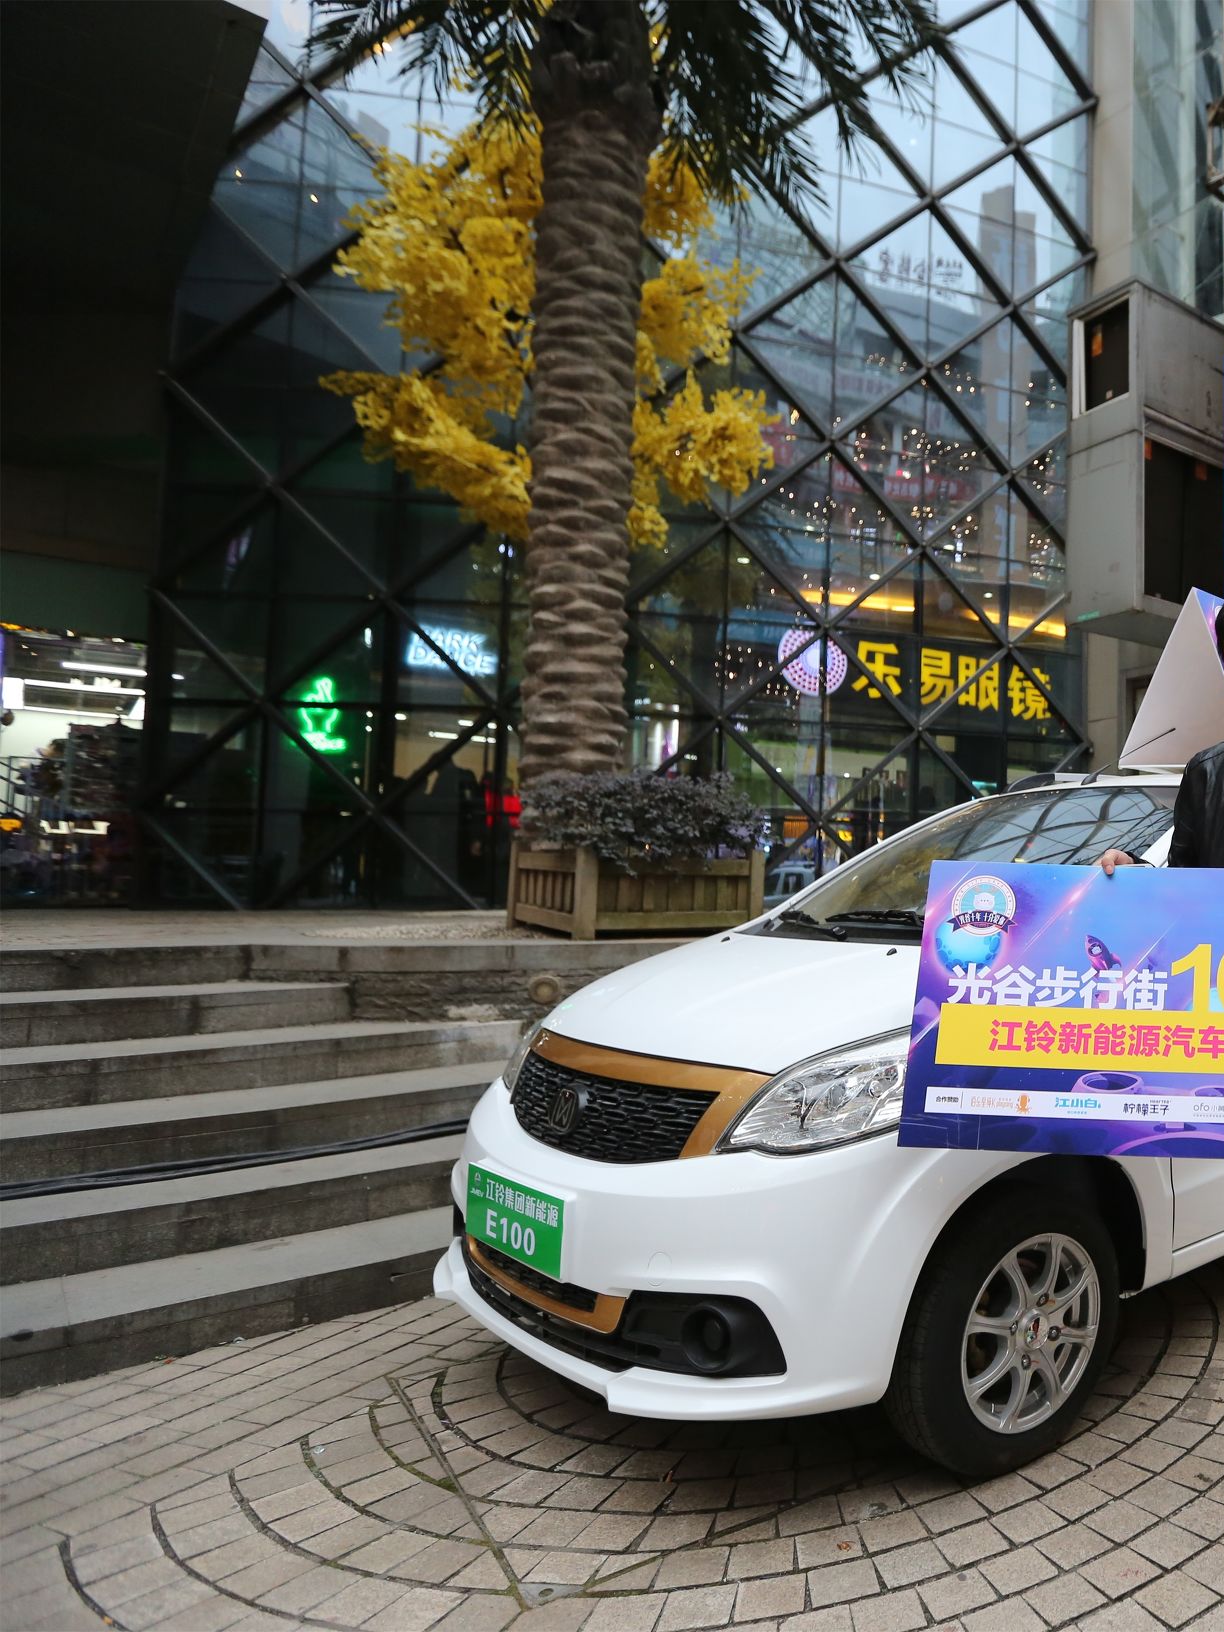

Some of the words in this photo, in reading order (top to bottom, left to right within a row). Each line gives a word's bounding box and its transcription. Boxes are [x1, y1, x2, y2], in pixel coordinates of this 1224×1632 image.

[851, 640, 1052, 721] 乐易眼镜
[1193, 1102, 1209, 1112] ofo
[486, 1178, 559, 1228] 江铃集团新能源
[486, 1208, 536, 1256] E100
